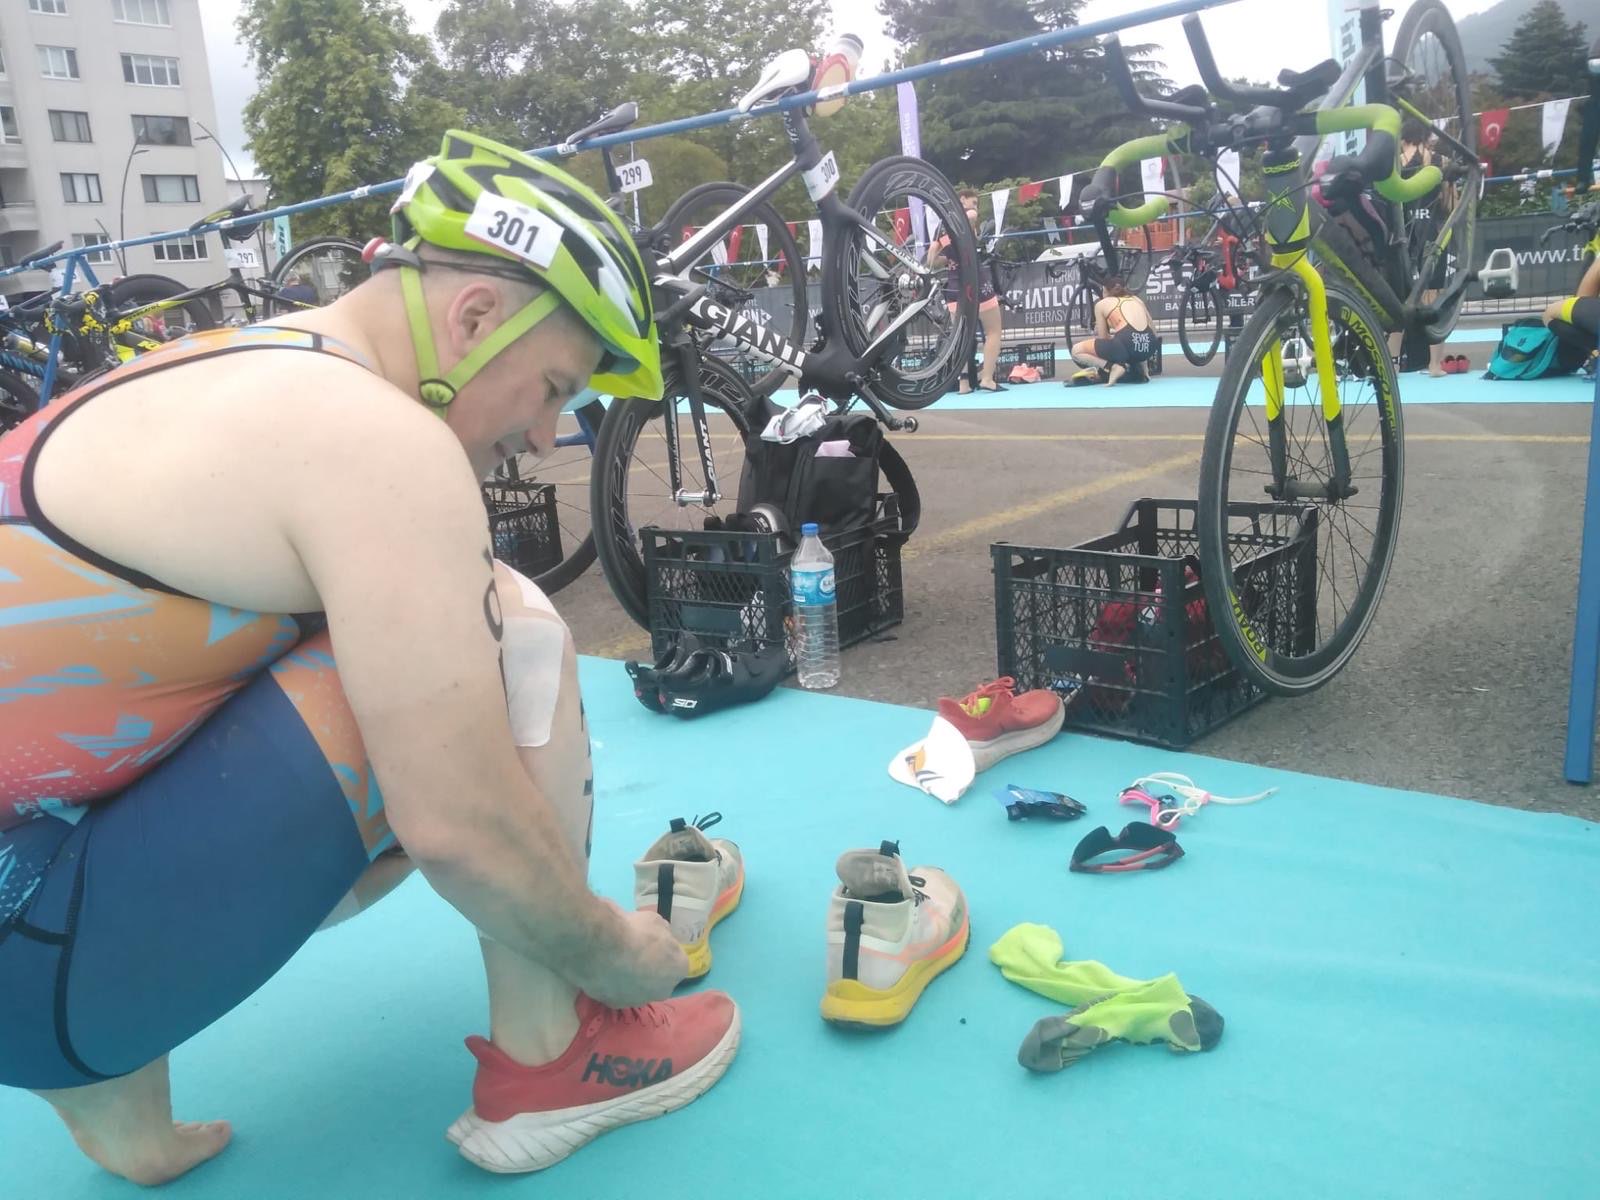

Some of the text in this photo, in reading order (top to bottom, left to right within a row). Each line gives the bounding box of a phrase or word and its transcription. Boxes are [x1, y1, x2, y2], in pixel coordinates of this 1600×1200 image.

[622, 165, 642, 186] 299
[487, 210, 540, 254] 301
[696, 297, 806, 367] GIANT
[1025, 308, 1088, 324] FEDERASYN
[699, 419, 716, 482] GIANT
[581, 1052, 673, 1089] HOKA
